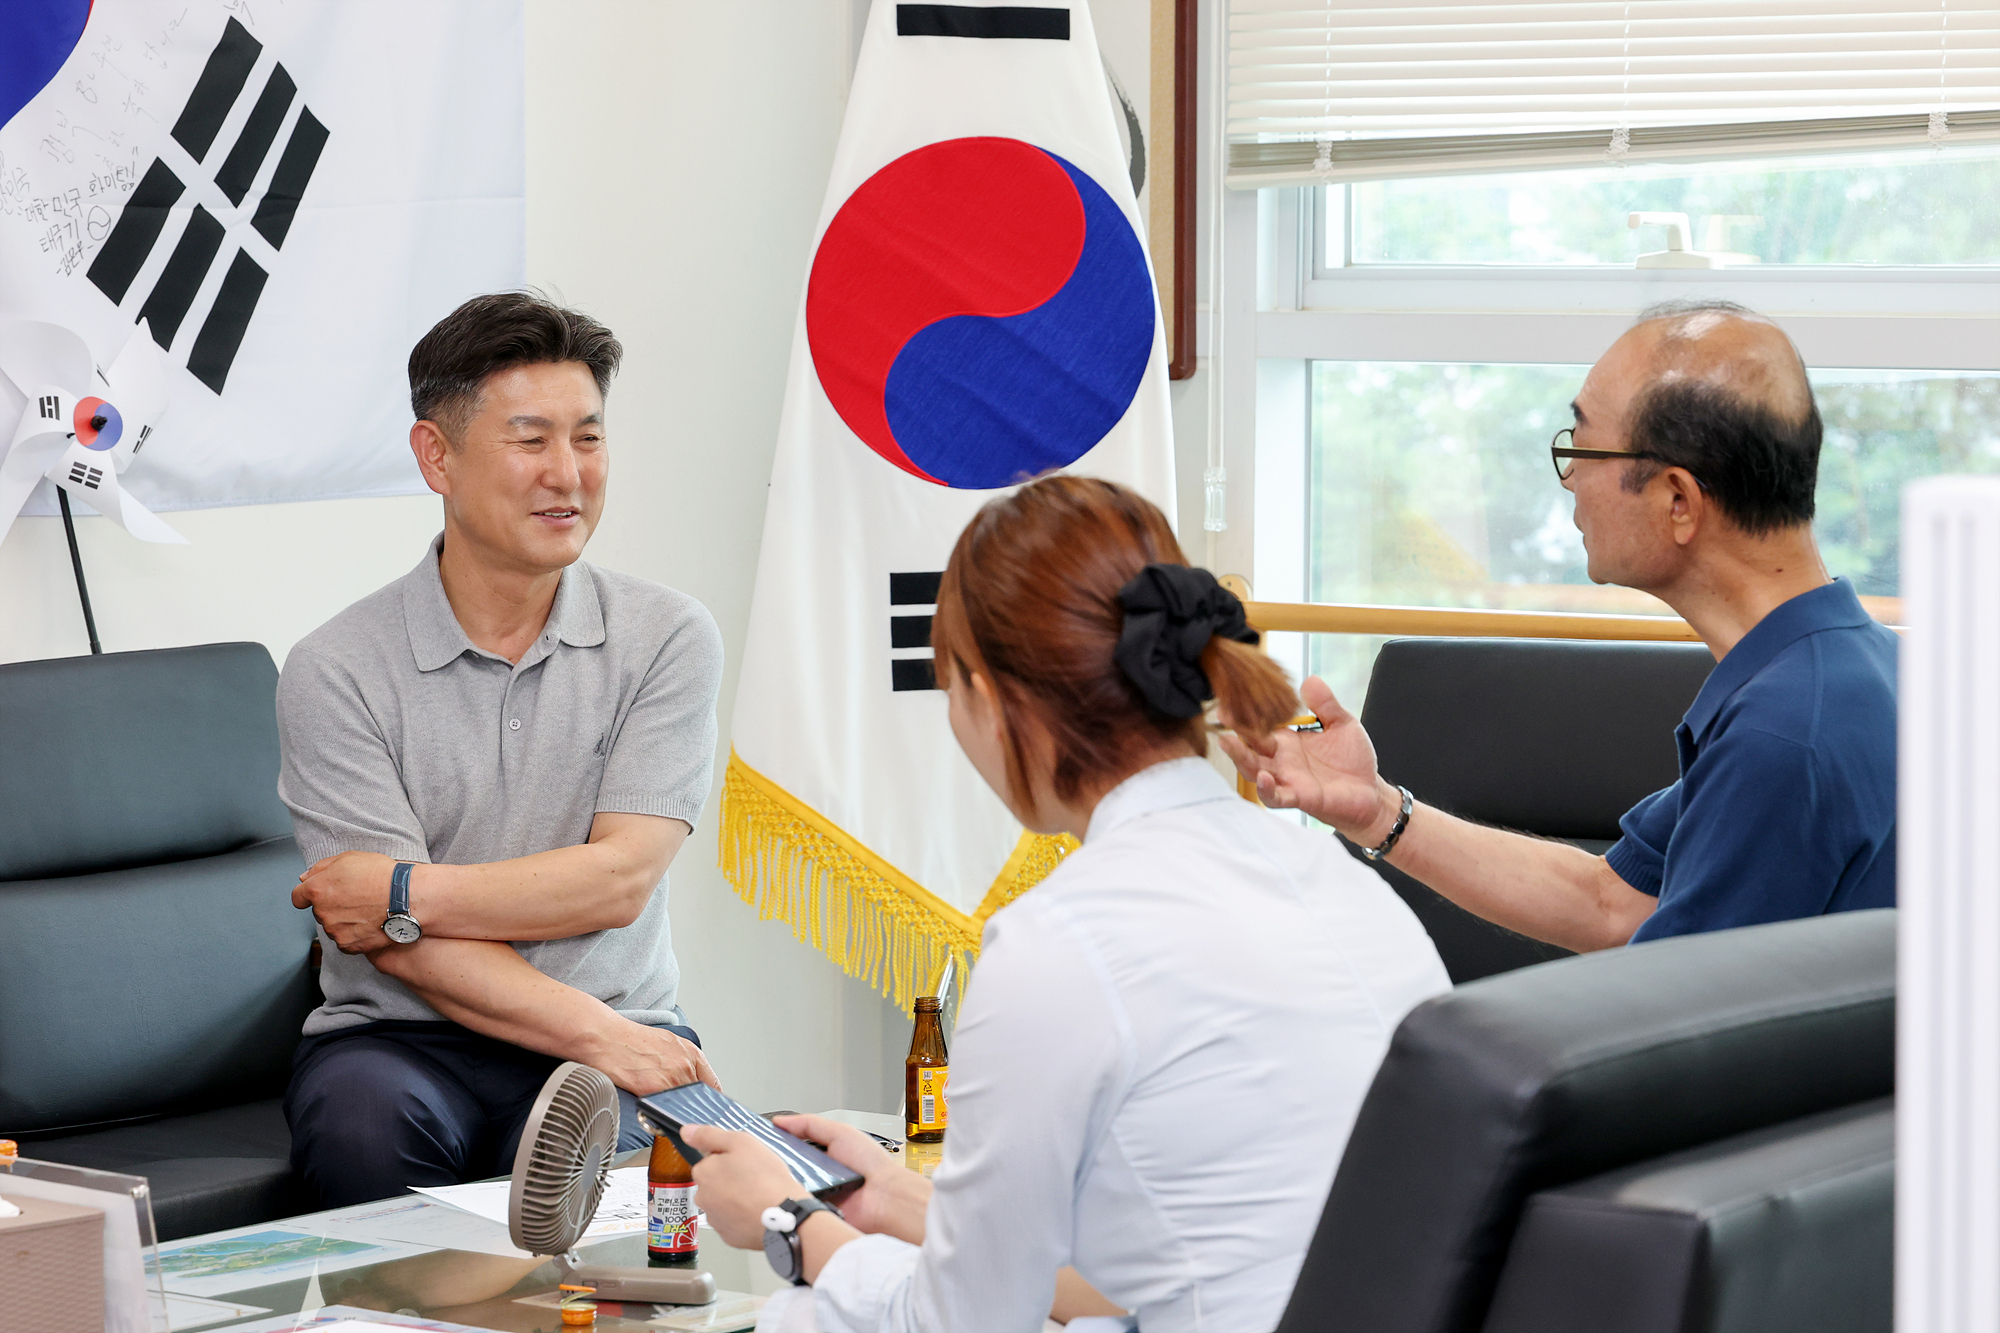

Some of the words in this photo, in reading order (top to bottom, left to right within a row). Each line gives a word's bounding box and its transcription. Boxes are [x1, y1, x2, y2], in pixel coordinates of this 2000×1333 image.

[39, 218, 81, 253] 태극기
[657, 1197, 688, 1207] 고려은단
[657, 1207, 688, 1215] 비타민C
[664, 1215, 687, 1223] 1000
